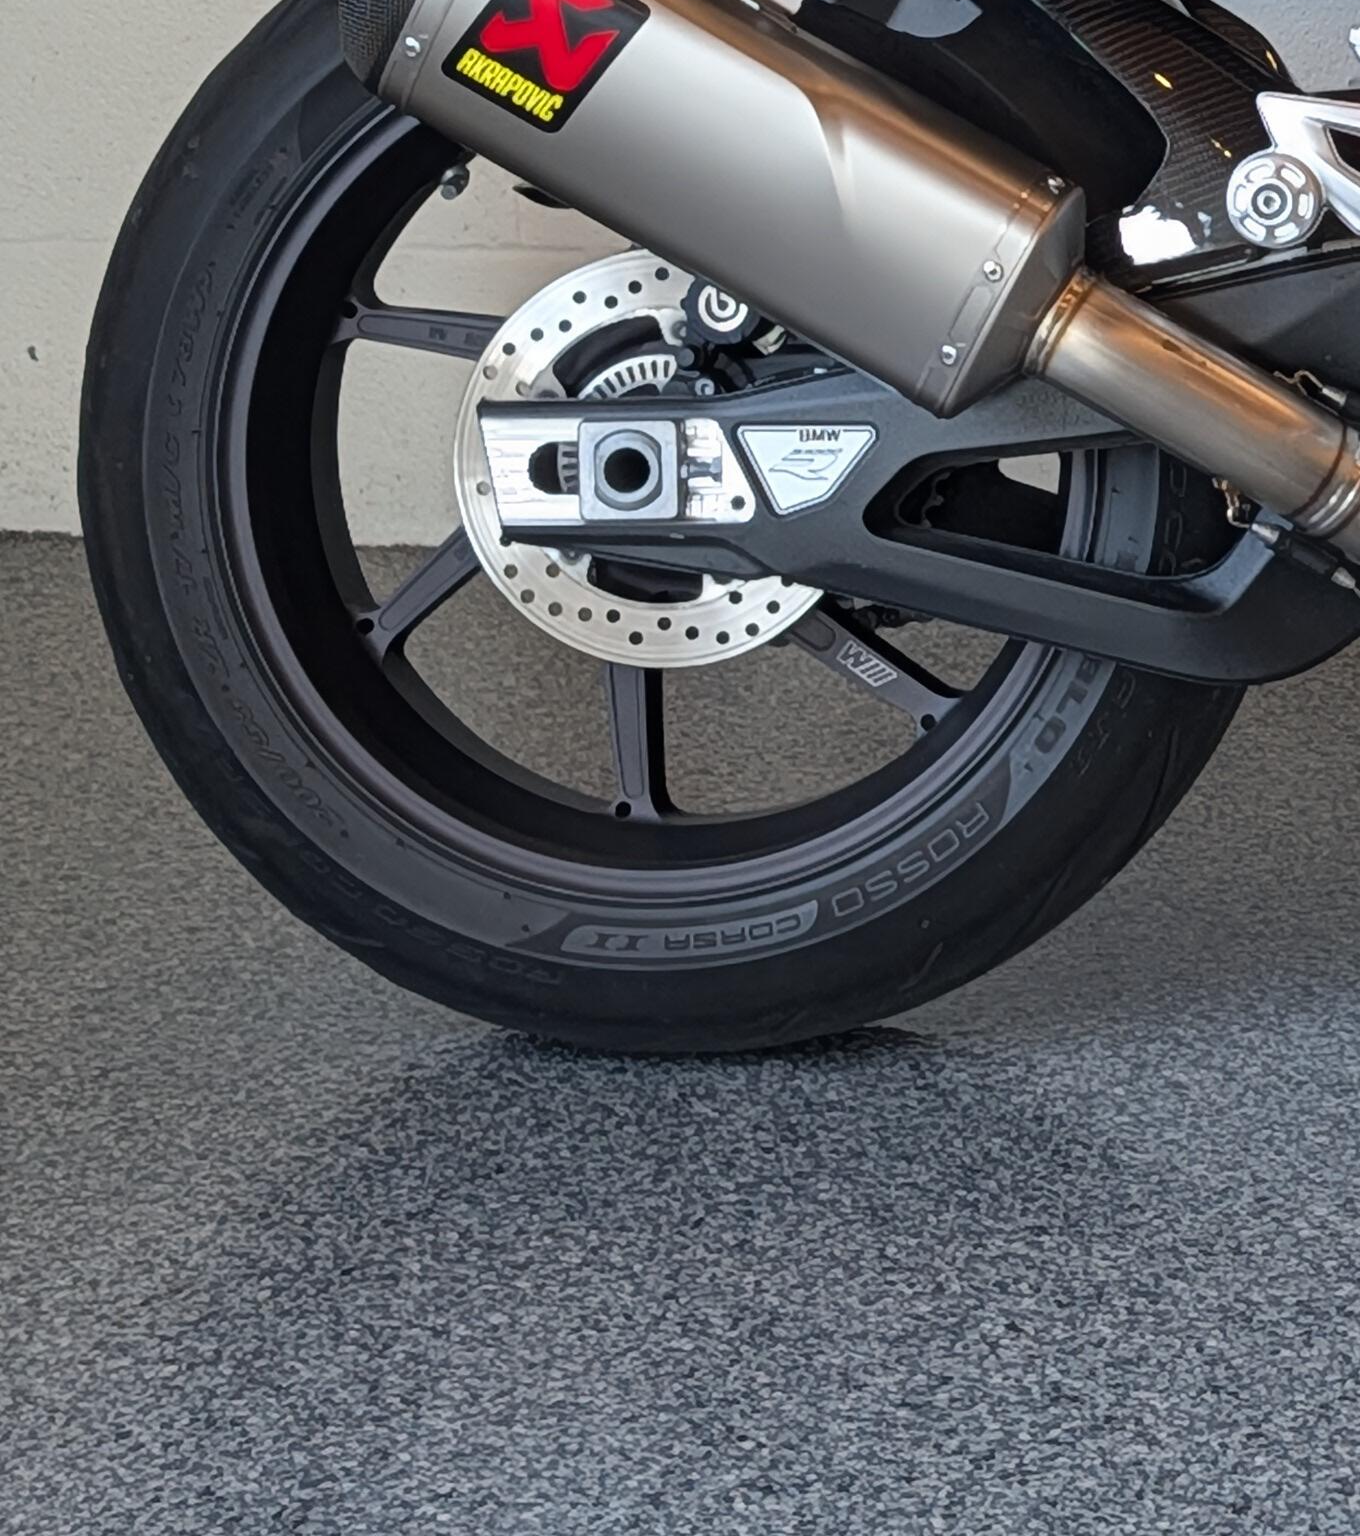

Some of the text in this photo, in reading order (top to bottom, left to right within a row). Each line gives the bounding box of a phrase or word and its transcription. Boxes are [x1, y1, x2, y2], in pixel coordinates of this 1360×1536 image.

[456, 47, 564, 123] AKRAPOVIC
[799, 429, 841, 442] BMW
[831, 801, 990, 918] ROSSO
[664, 915, 801, 951] CORSA
